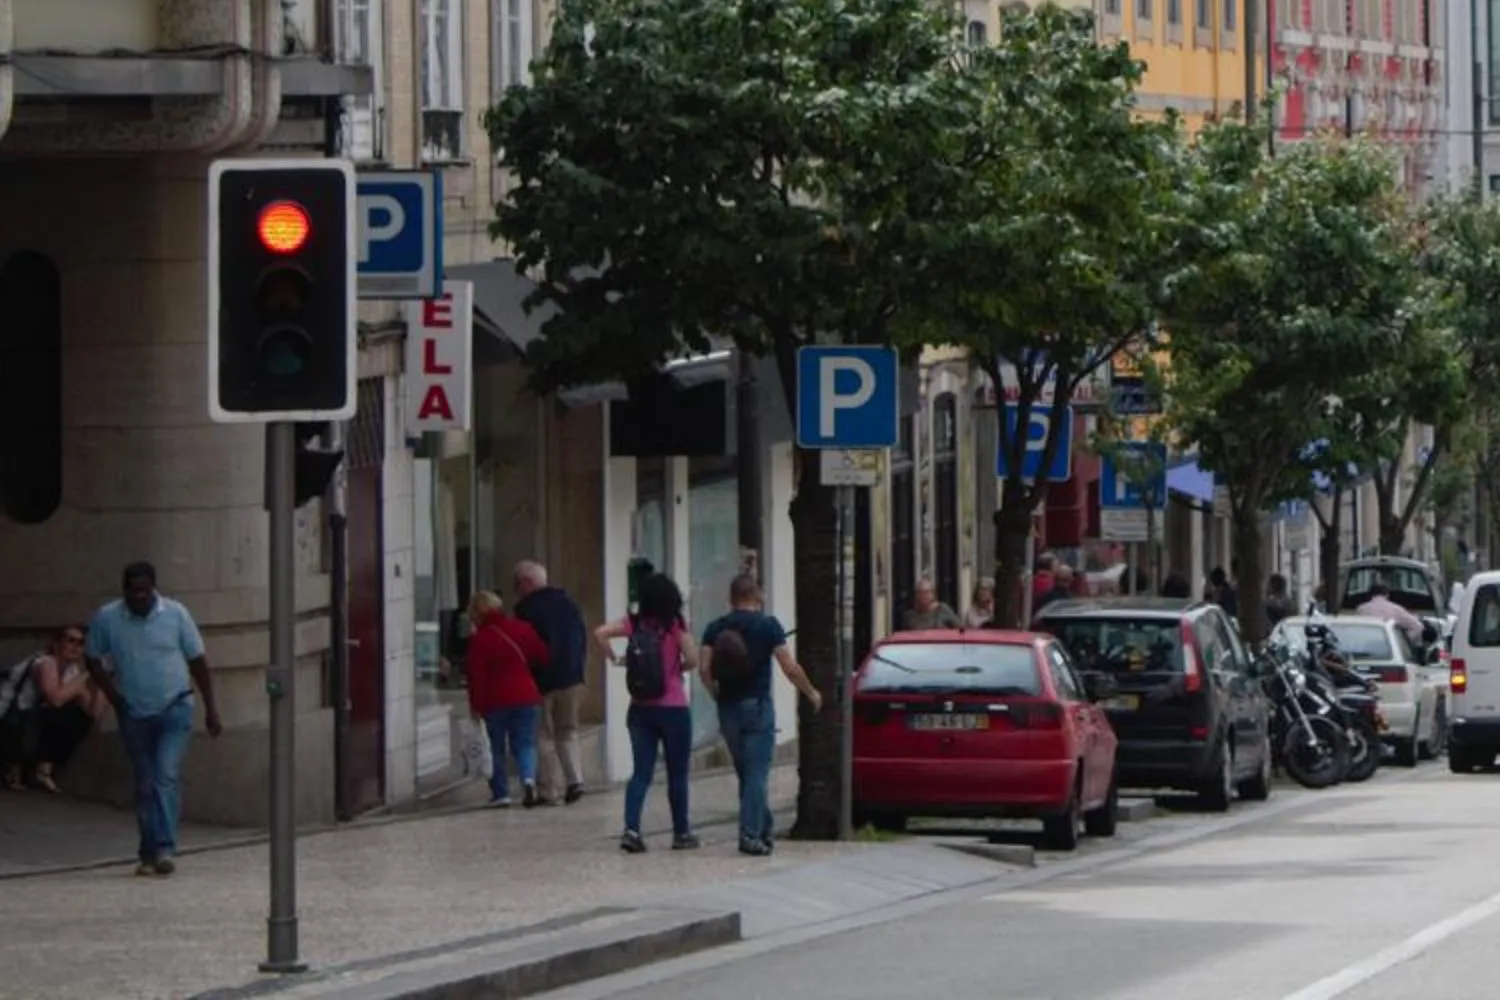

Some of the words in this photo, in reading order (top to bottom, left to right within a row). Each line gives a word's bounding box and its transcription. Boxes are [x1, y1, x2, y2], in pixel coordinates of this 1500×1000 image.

[357, 194, 405, 262] P
[417, 292, 454, 421] ELA
[819, 355, 877, 438] P
